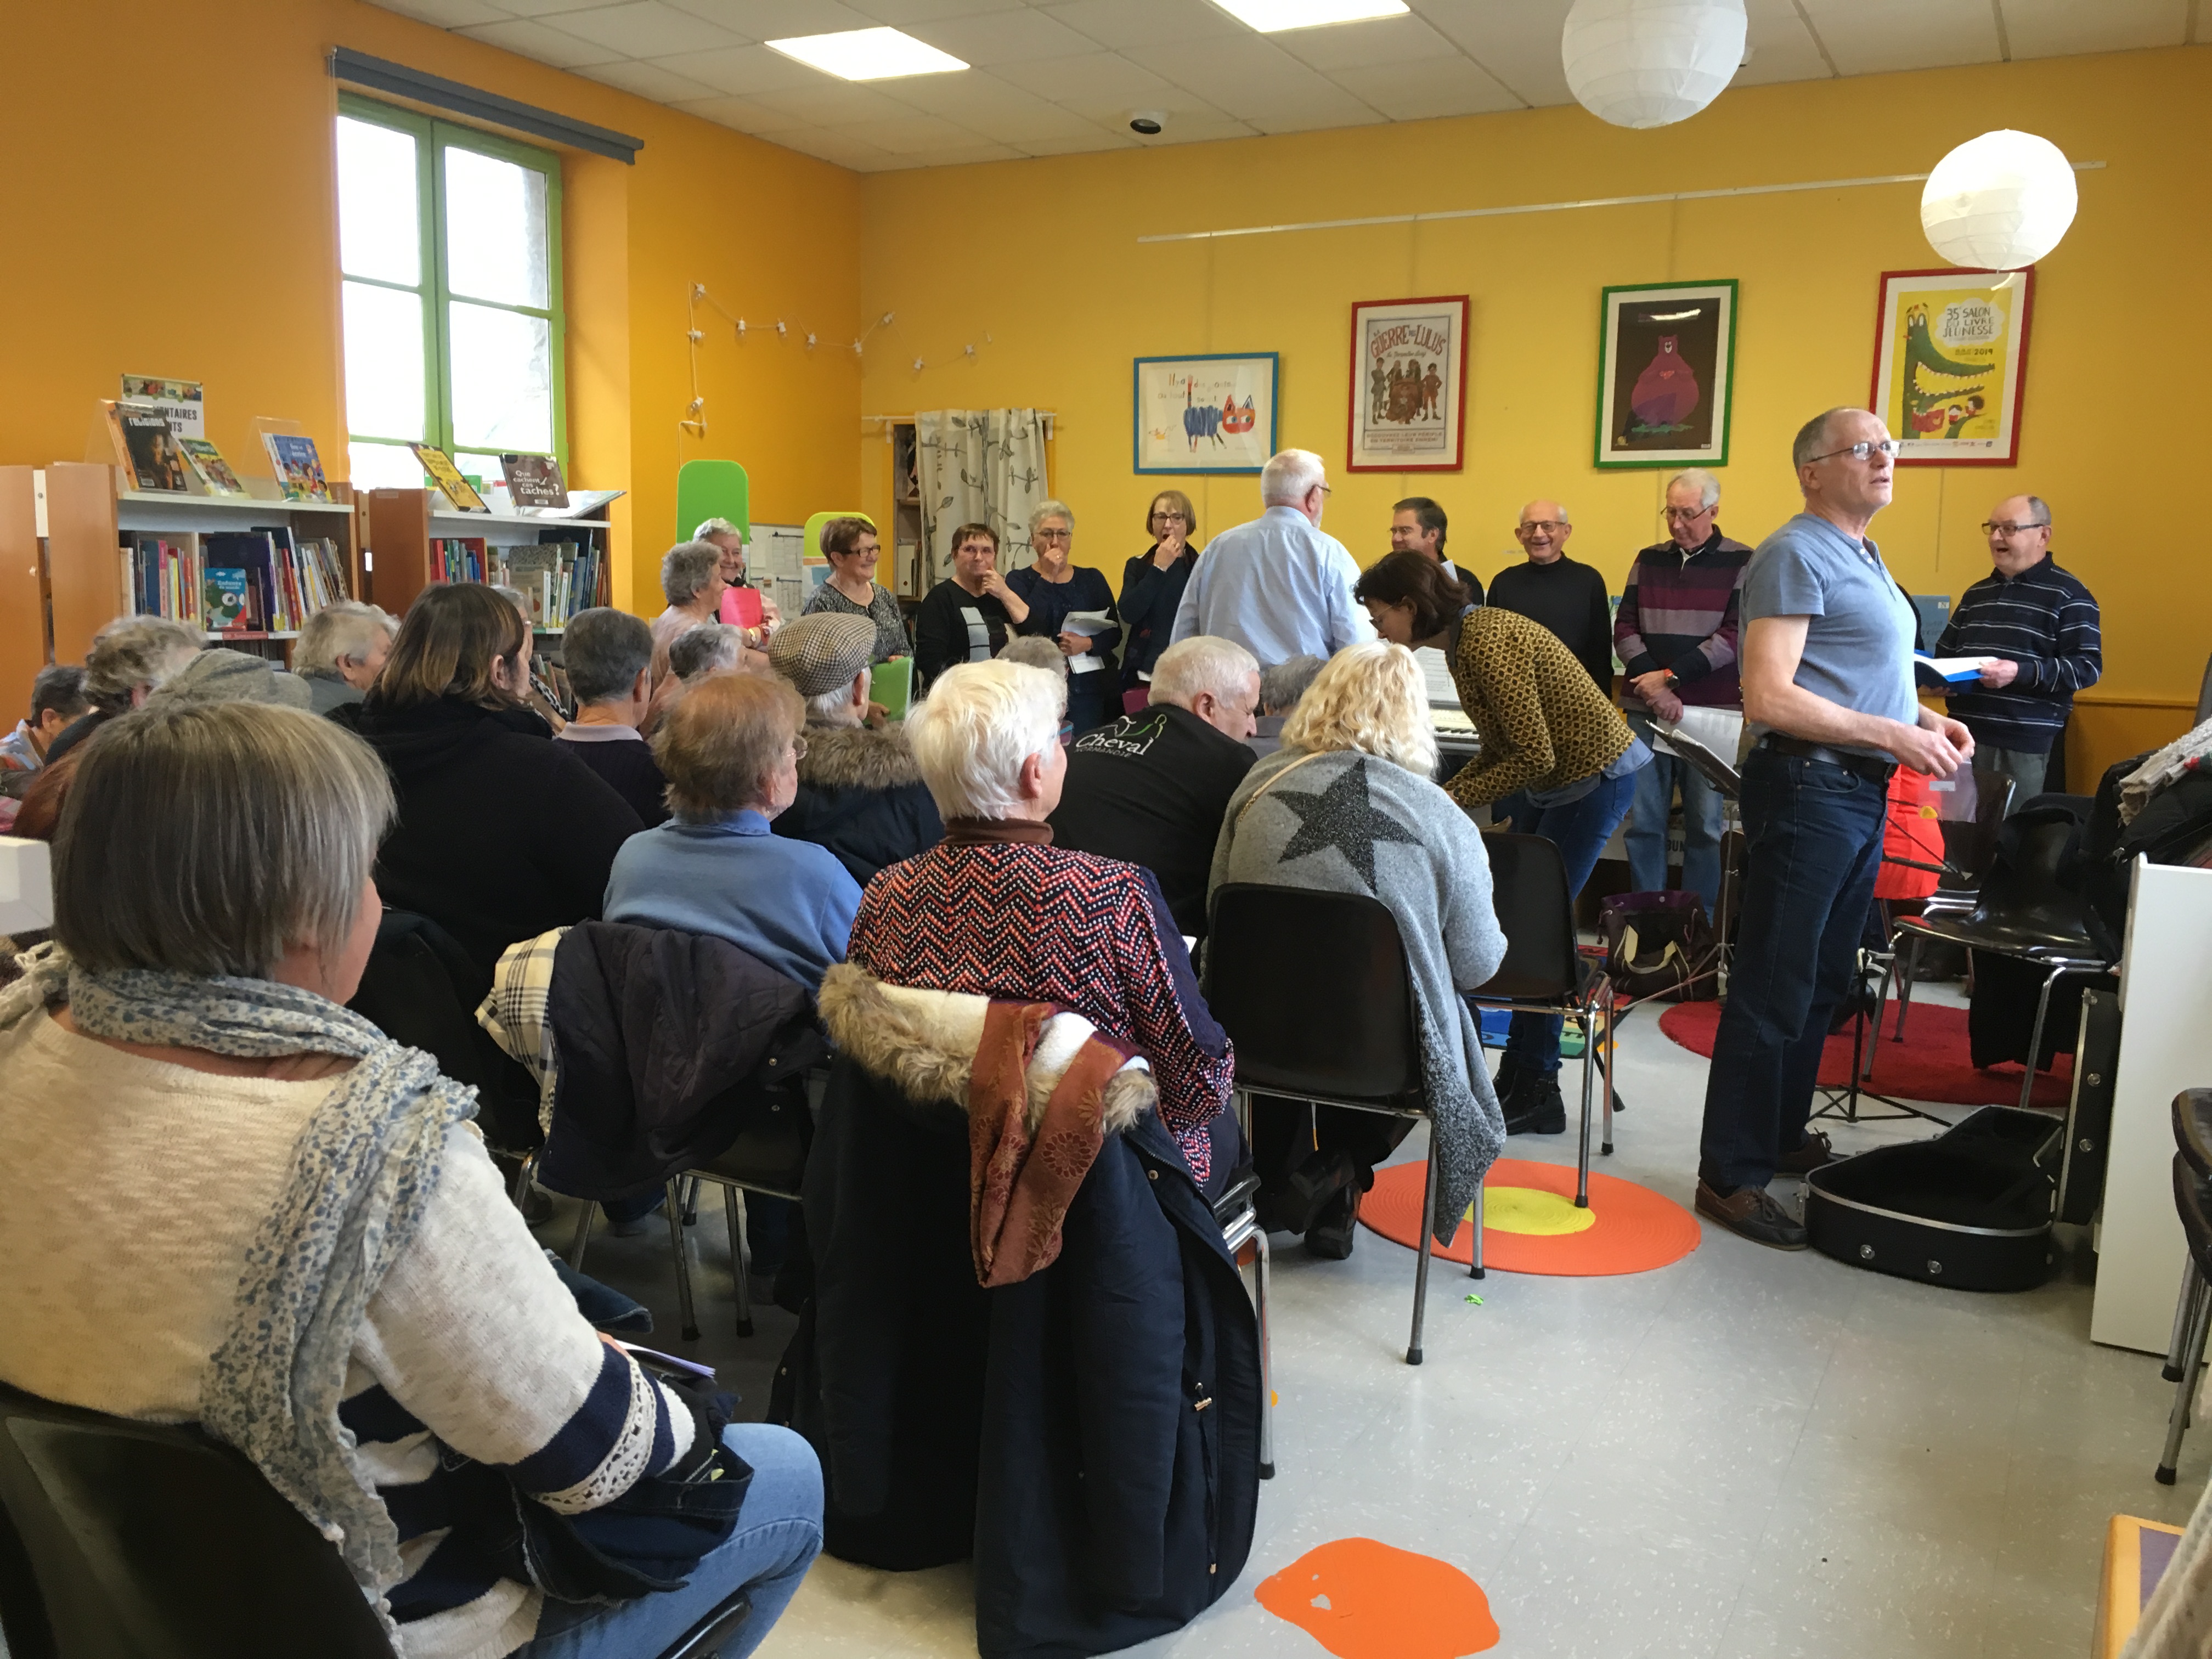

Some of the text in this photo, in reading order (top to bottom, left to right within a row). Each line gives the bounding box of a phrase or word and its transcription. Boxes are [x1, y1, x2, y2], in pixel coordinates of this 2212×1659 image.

[1962, 307, 1990, 318] SALON
[1946, 317, 1994, 329] DU LIVRE
[1943, 325, 1994, 338] JEUNESSE
[1370, 325, 1410, 358] GUERRE
[1414, 324, 1447, 356] LULUS
[159, 407, 197, 420] NTAIRES
[1075, 733, 1154, 755] Cheval
